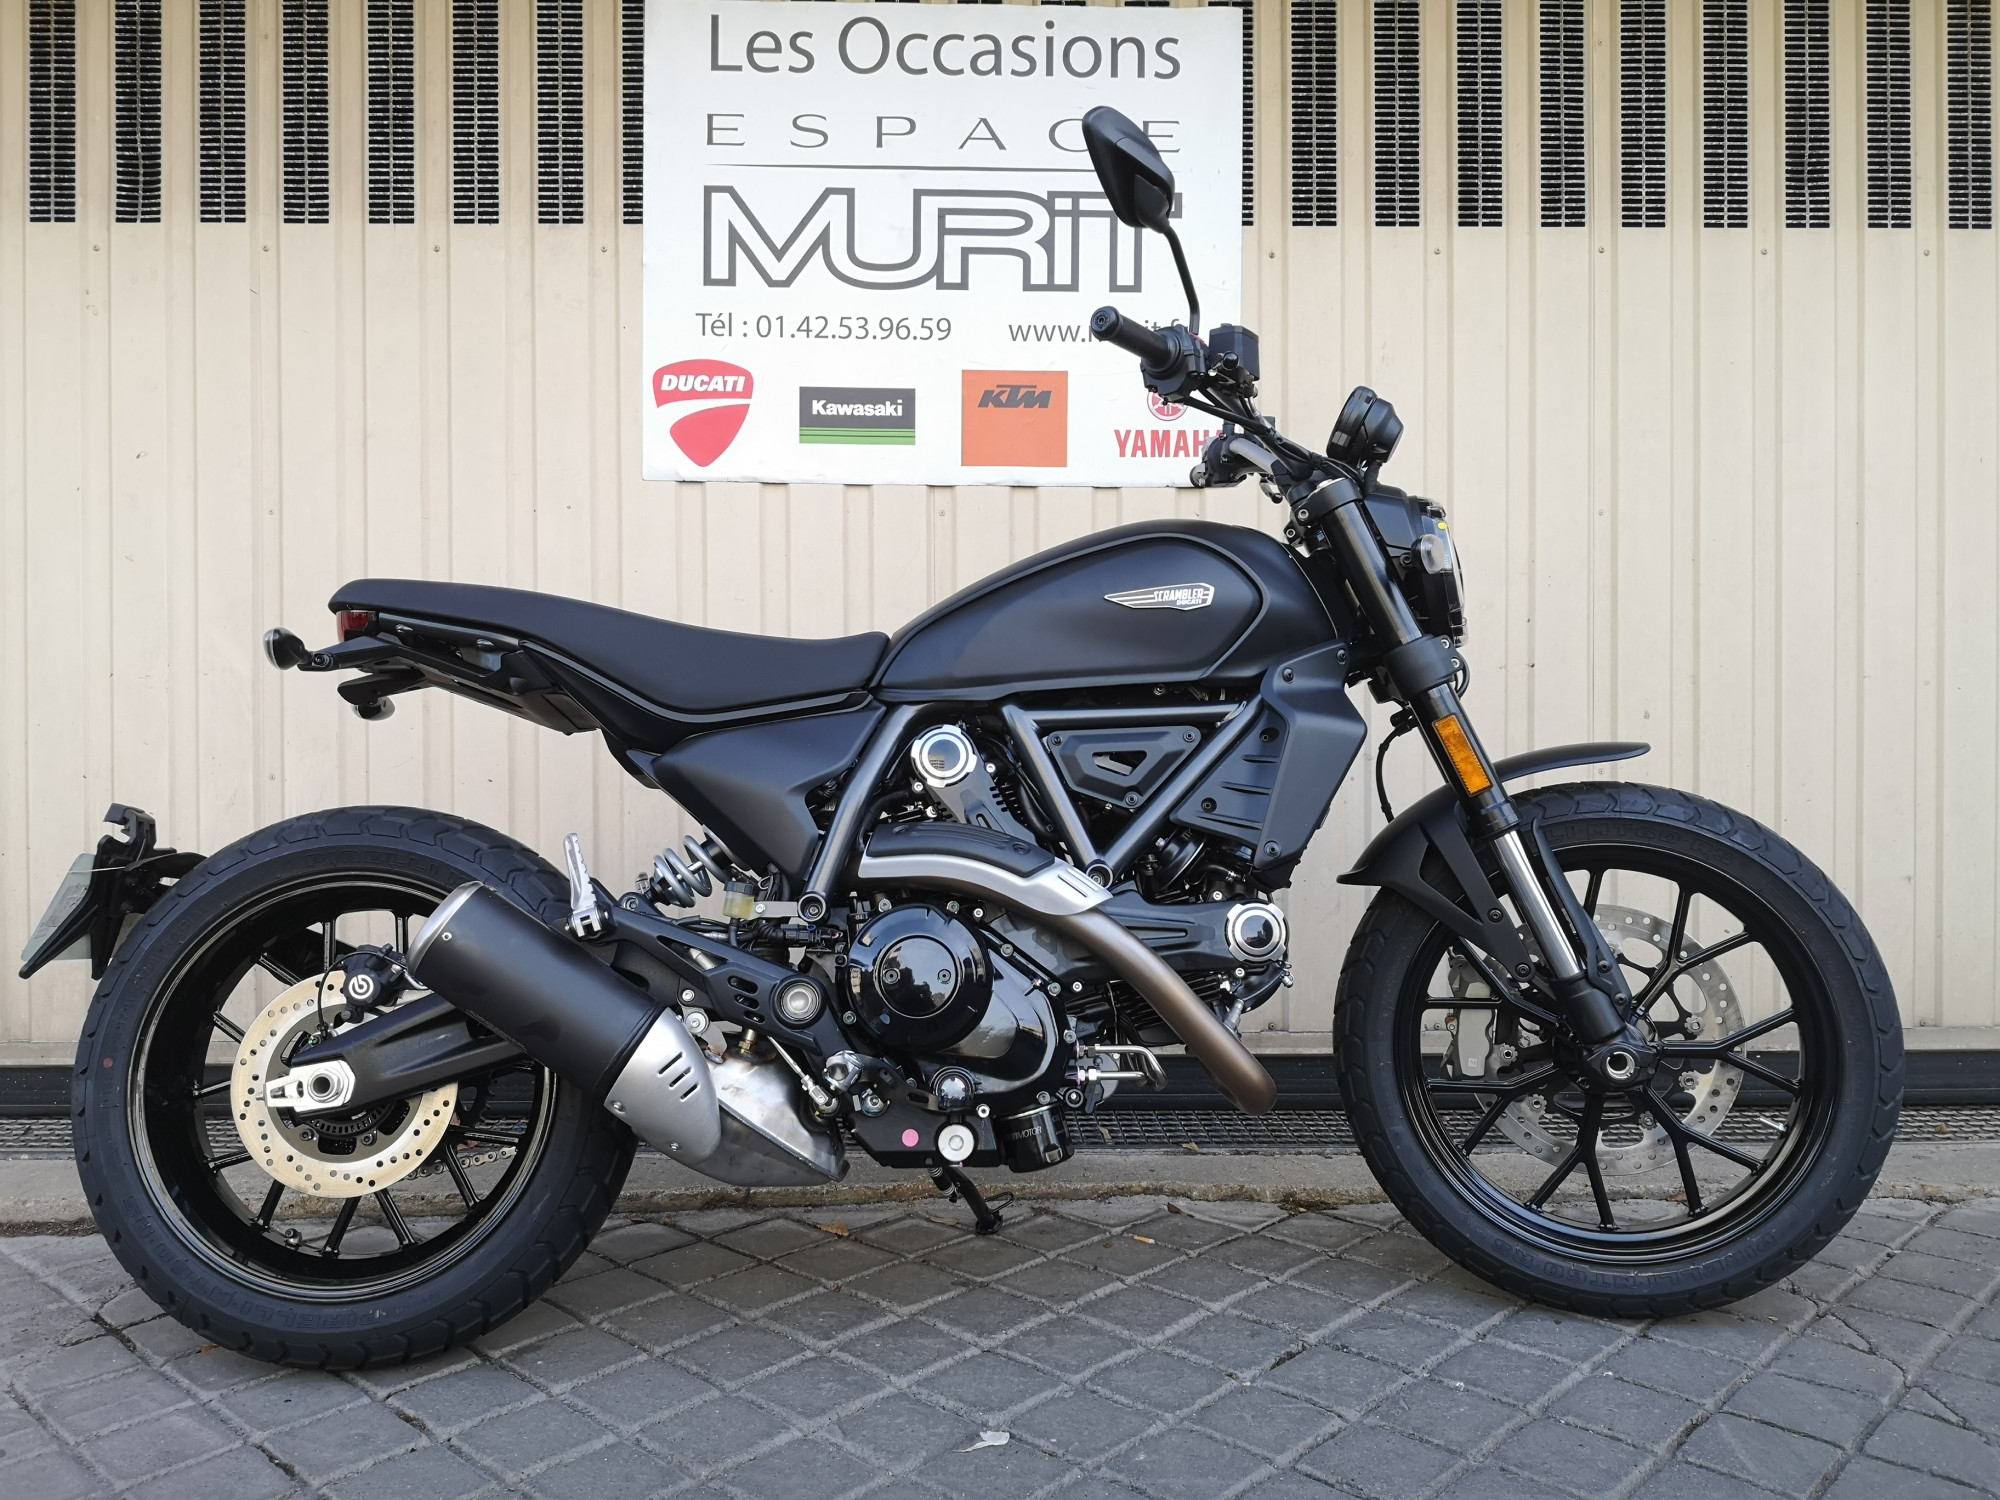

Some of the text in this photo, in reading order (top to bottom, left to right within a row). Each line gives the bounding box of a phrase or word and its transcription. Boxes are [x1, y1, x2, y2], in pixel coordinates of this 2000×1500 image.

[710, 13, 1181, 79] Les Occasions
[706, 113, 1181, 153] ESPACE
[695, 312, 733, 337] Tél
[756, 315, 952, 341] 01.42.53.96.59
[660, 374, 746, 393] DUCATI
[977, 384, 1052, 409] KTM
[811, 399, 903, 417] Kawasaki
[1114, 429, 1224, 458] YAMAH
[1153, 588, 1204, 602] SCRAMBLER
